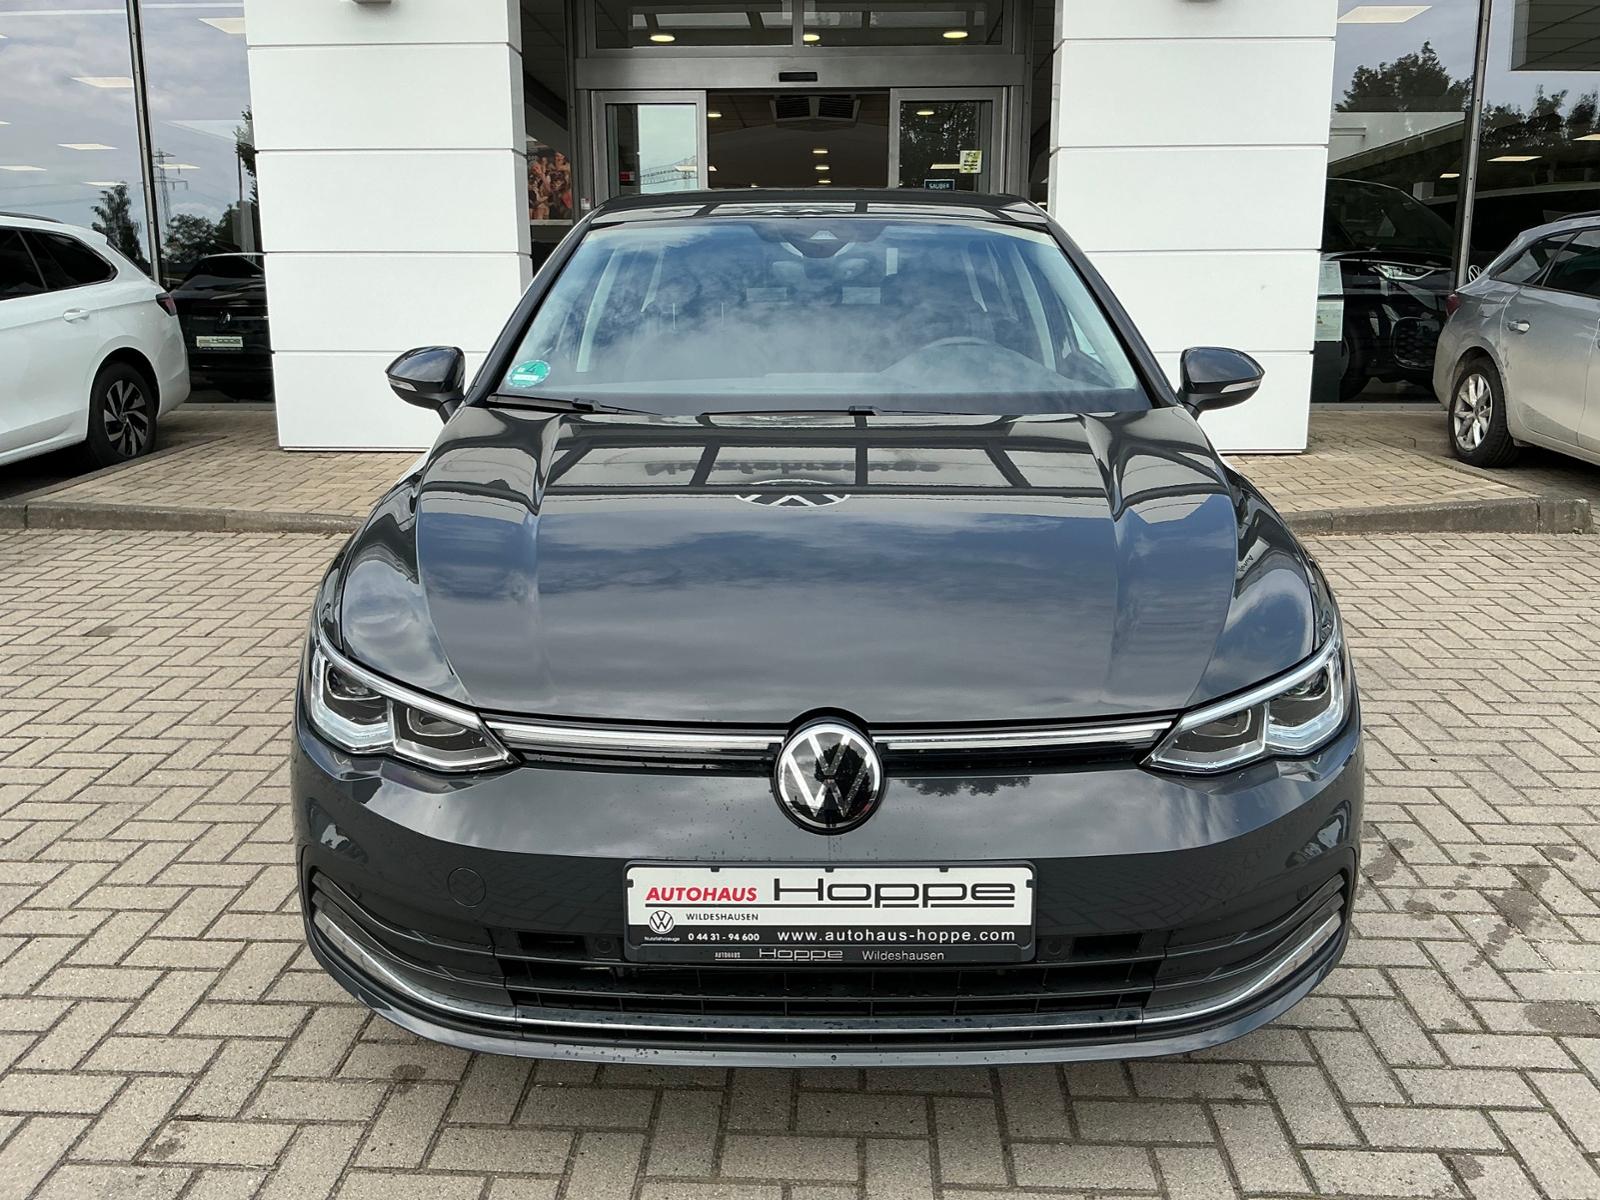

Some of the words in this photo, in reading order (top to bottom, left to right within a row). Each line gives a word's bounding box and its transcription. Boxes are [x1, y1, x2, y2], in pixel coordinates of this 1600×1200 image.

[645, 887, 758, 902] AUTOHAUS
[773, 878, 1016, 908] Hoppe
[685, 913, 759, 921] WILDESHAUSEN
[688, 933, 694, 941] 0
[696, 933, 708, 941] 44
[710, 933, 720, 941] 31
[728, 933, 740, 941] 94
[742, 933, 760, 941] 600
[777, 929, 1016, 944] www.autohaus-hoppe.com
[759, 948, 844, 962] Hoppe
[862, 950, 945, 962] Wildeshausen
